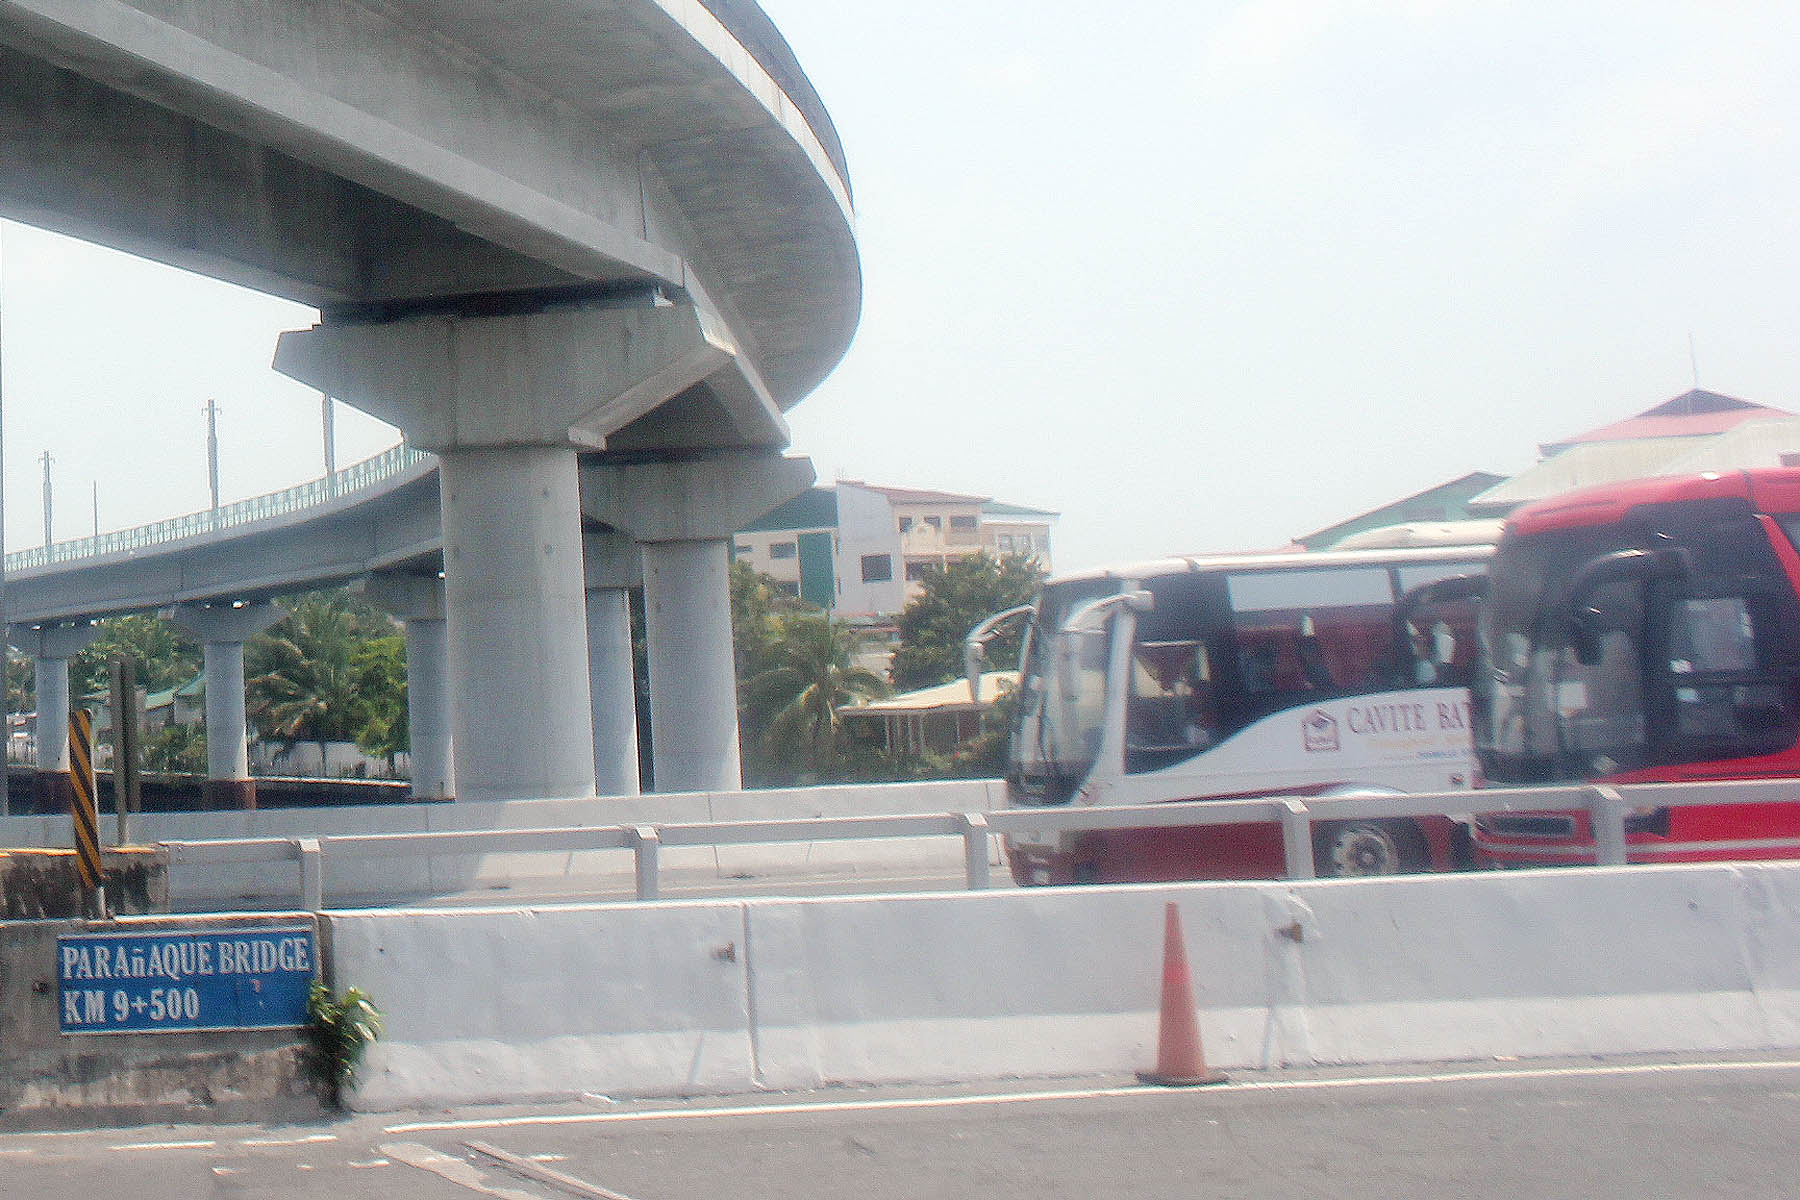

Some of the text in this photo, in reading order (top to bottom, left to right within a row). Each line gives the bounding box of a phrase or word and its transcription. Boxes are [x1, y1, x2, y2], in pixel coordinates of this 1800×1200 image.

[1348, 703, 1425, 733] CAVITE
[218, 938, 311, 974] BRIDGE
[64, 988, 200, 1023] KM 9+500
